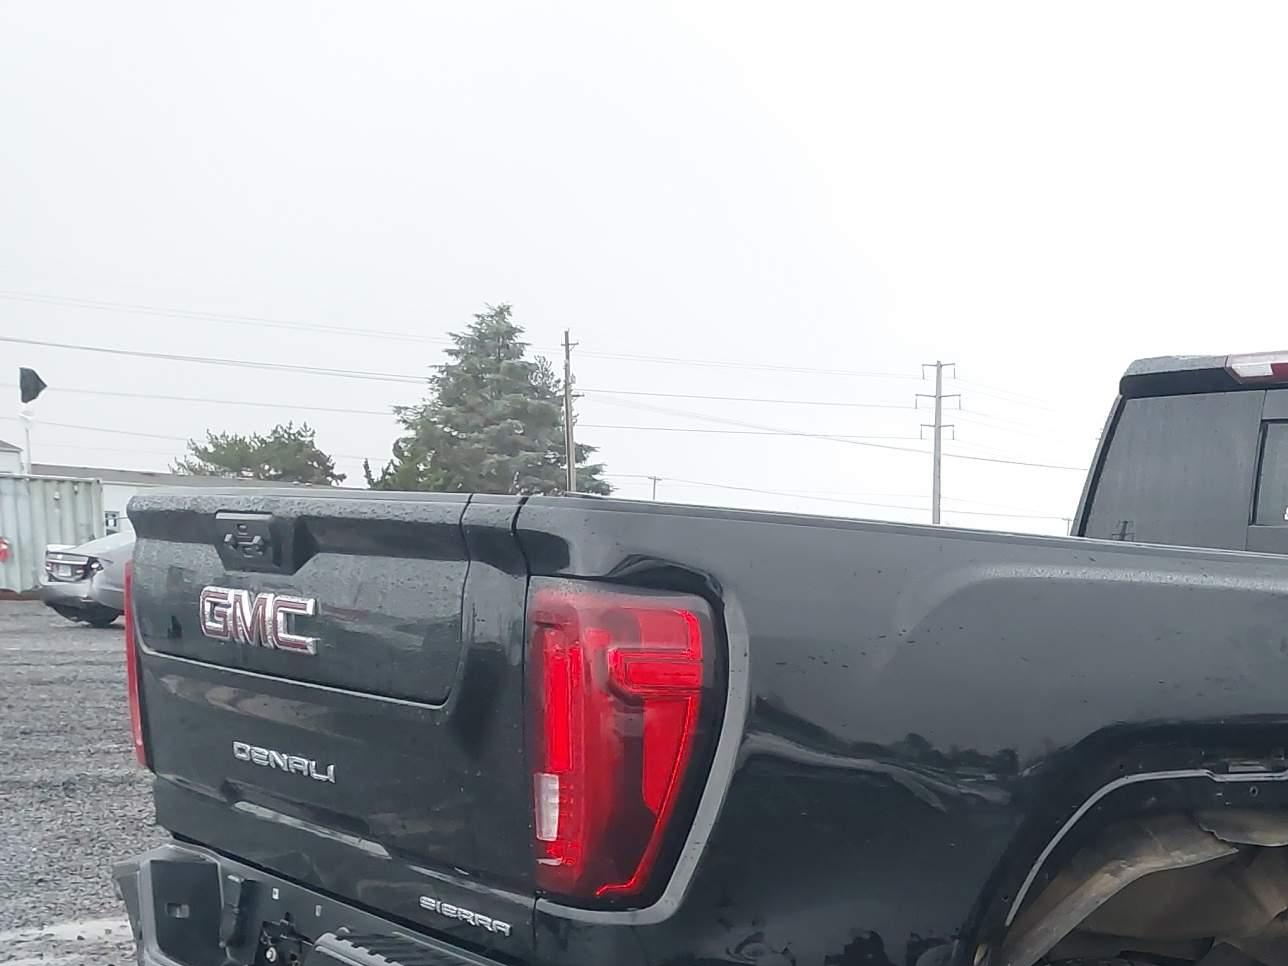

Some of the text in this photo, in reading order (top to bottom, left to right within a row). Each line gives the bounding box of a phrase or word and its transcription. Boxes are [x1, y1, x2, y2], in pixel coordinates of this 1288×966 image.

[200, 586, 319, 655] GMC
[233, 741, 336, 784] DENALI
[419, 895, 511, 937] SIERRA
